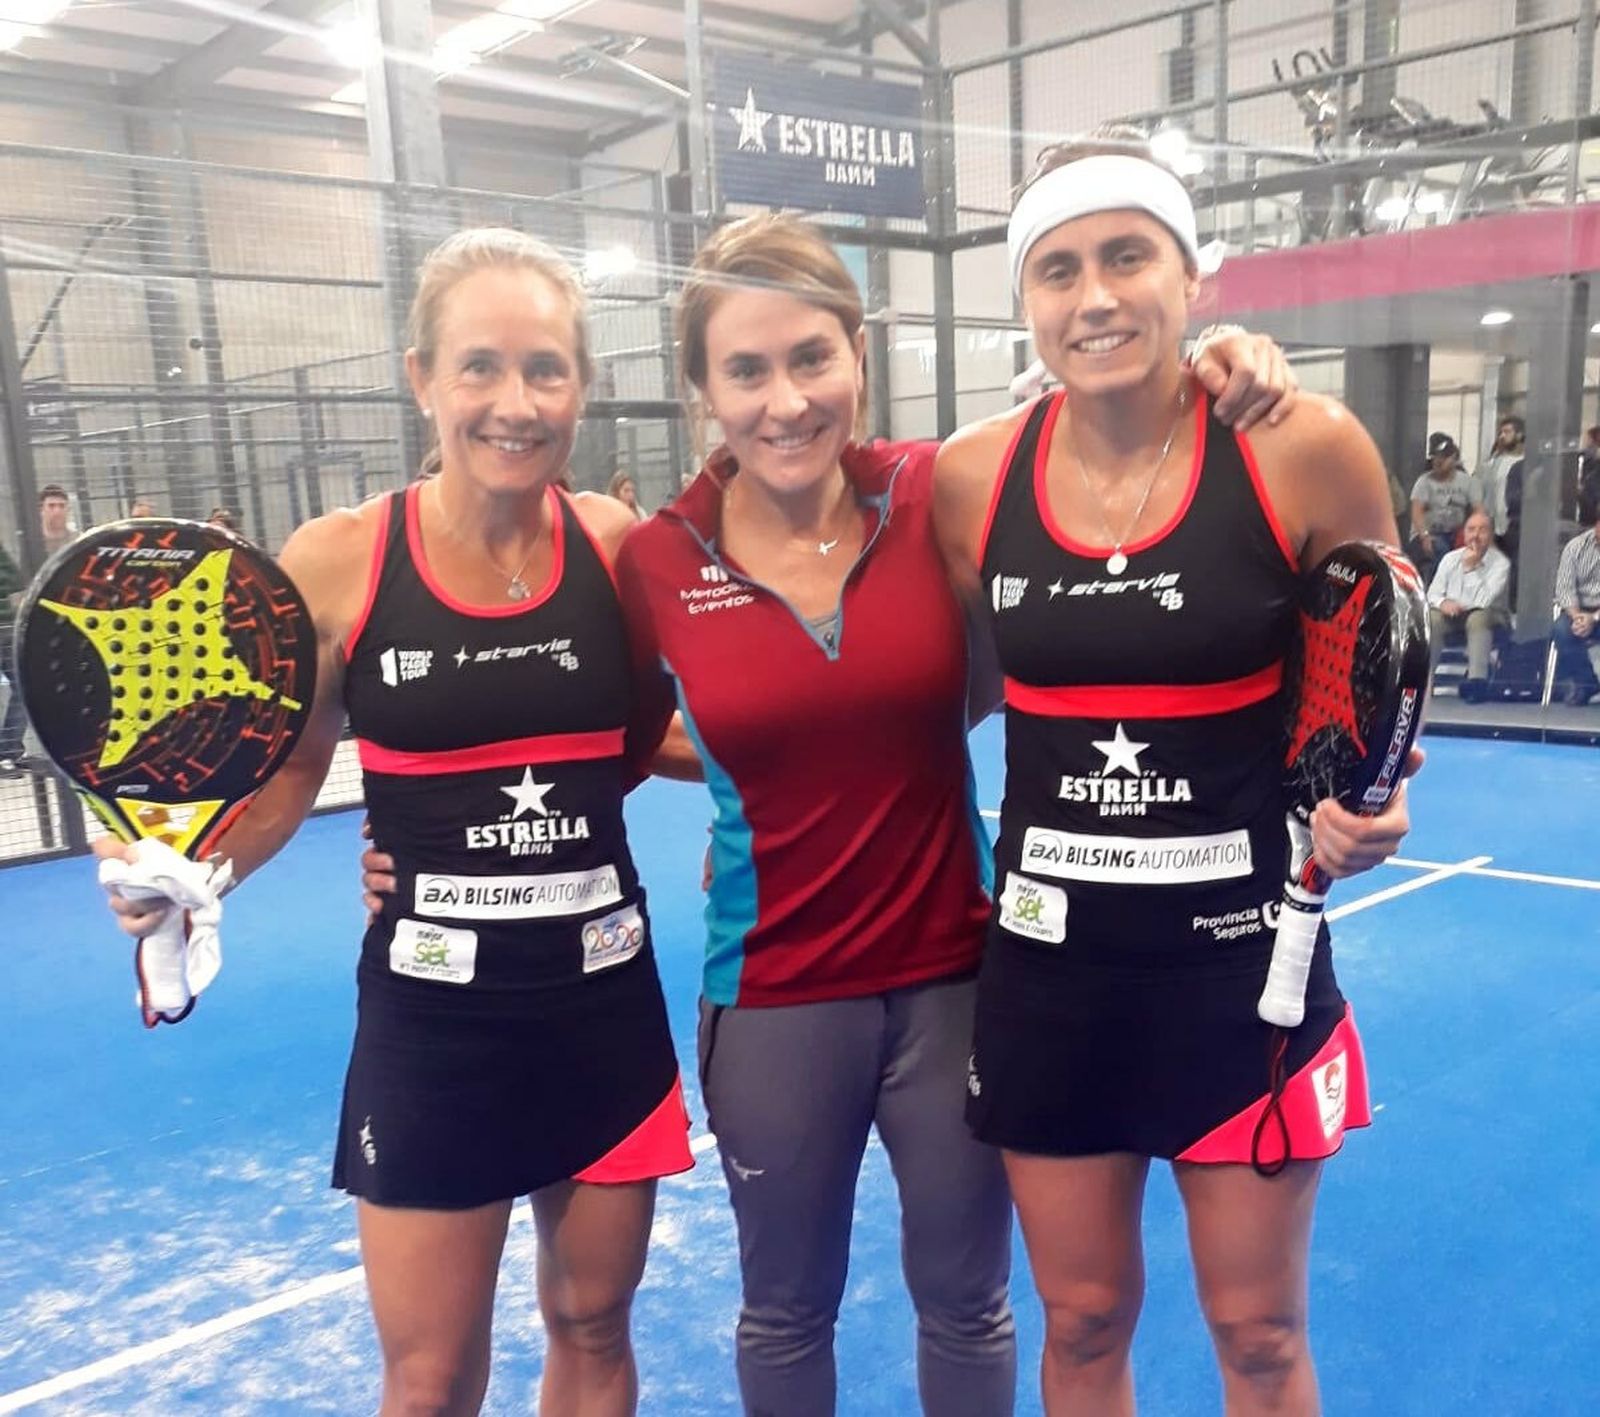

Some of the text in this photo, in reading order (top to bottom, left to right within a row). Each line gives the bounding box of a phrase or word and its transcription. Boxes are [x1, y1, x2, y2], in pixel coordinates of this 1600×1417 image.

[778, 114, 915, 168] ESTRELLA
[825, 162, 875, 187] DAMM
[1058, 774, 1193, 803] ESTRELLA
[465, 815, 590, 849] ESTRELLA
[1065, 845, 1136, 869] BILSING
[1137, 842, 1248, 869] AUTOMATION
[464, 886, 535, 905] BILSING
[536, 875, 618, 903] AUTOMATION
[1193, 908, 1259, 931] Provincia
[1213, 921, 1262, 940] Seguros
